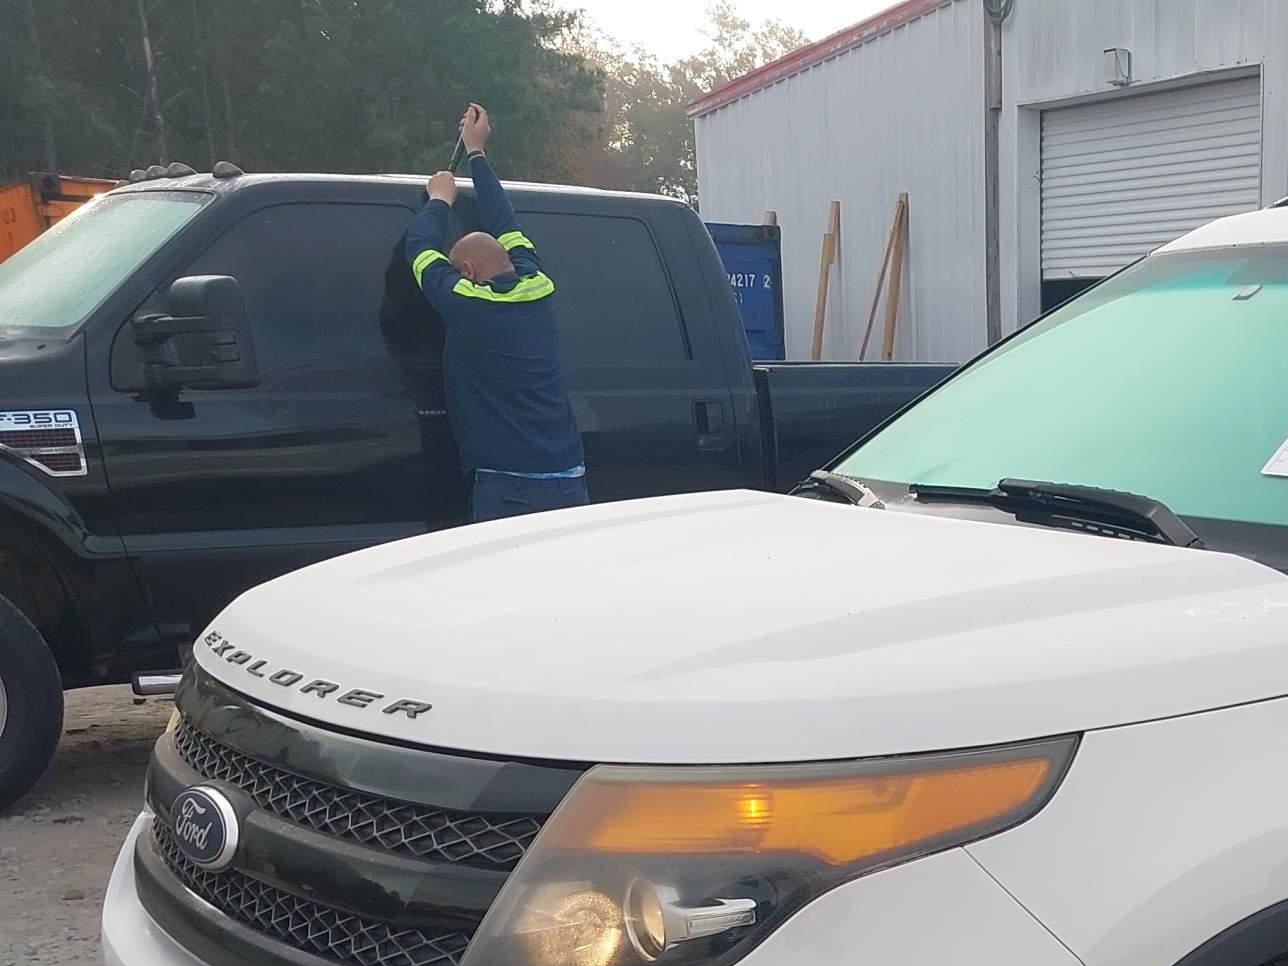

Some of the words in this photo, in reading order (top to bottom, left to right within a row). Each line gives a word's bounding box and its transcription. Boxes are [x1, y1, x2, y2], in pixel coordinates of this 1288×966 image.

[727, 273, 756, 288] 4217
[203, 630, 433, 719] EXPLORER
[176, 797, 213, 850] Ford
